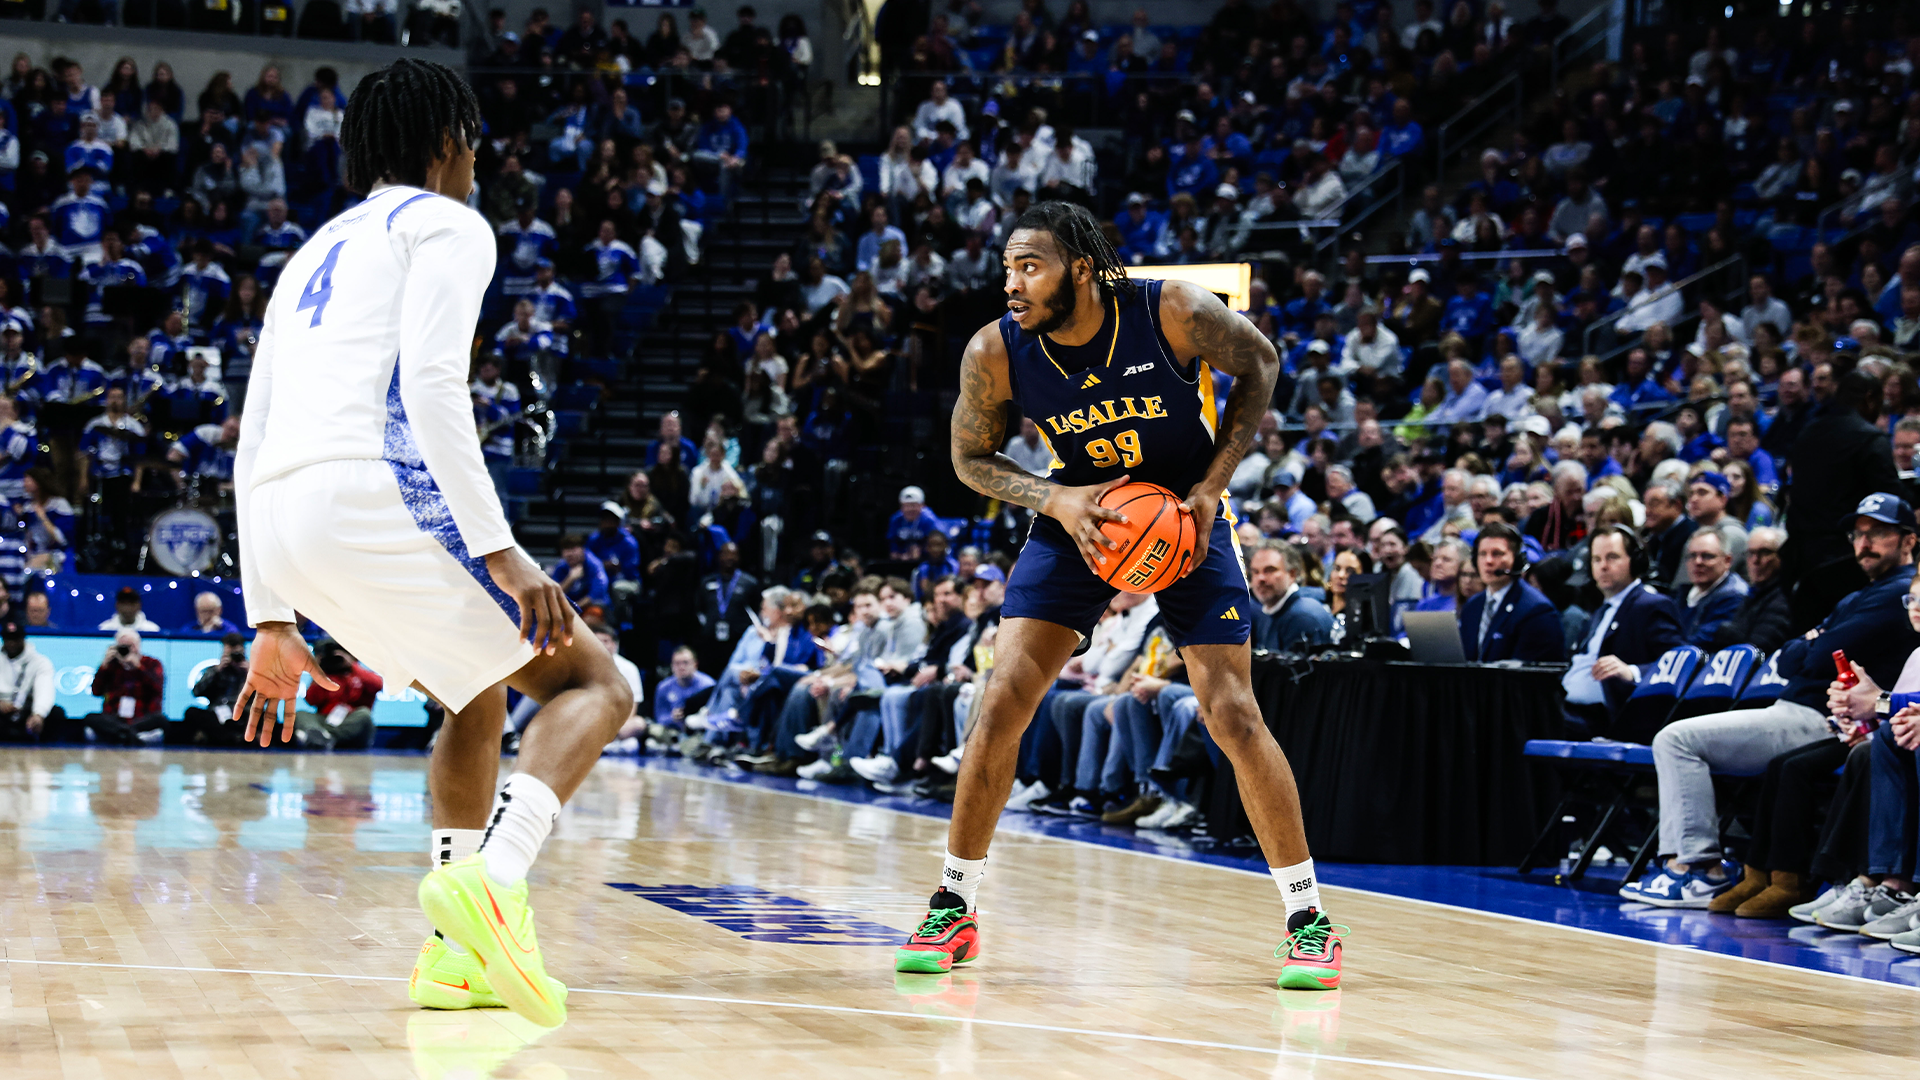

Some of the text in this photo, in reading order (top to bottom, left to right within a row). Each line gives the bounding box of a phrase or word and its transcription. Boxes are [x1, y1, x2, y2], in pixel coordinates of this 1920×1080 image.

[296, 239, 349, 328] 4
[1122, 362, 1155, 377] A10
[1085, 429, 1143, 468] 99
[1121, 537, 1156, 580] HAMPIONSHIP
[1124, 537, 1172, 587] ELITE
[1289, 877, 1313, 893] 3SSB
